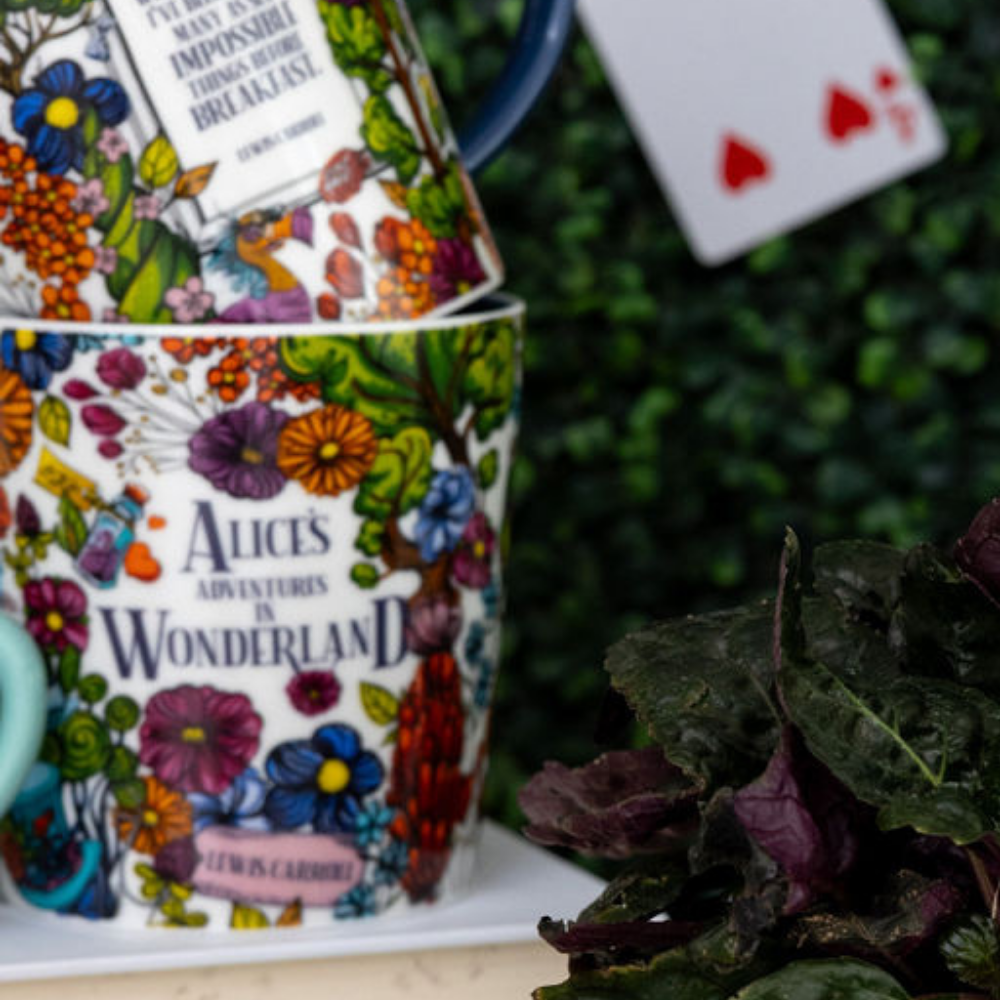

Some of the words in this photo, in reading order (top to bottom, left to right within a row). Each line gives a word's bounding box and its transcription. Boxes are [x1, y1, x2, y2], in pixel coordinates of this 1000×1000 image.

[170, 0, 298, 79] IMPOSSIBLE
[172, 8, 222, 40] MANY
[189, 58, 250, 99] THINGS
[250, 30, 303, 70] BEFORE
[189, 52, 323, 132] BREAKFAST.
[180, 499, 331, 573] ALICE'S
[196, 574, 328, 600] ADVENTURES
[255, 599, 276, 622] IN
[97, 598, 408, 680] WONDERLAND
[206, 849, 266, 878] LEWIS
